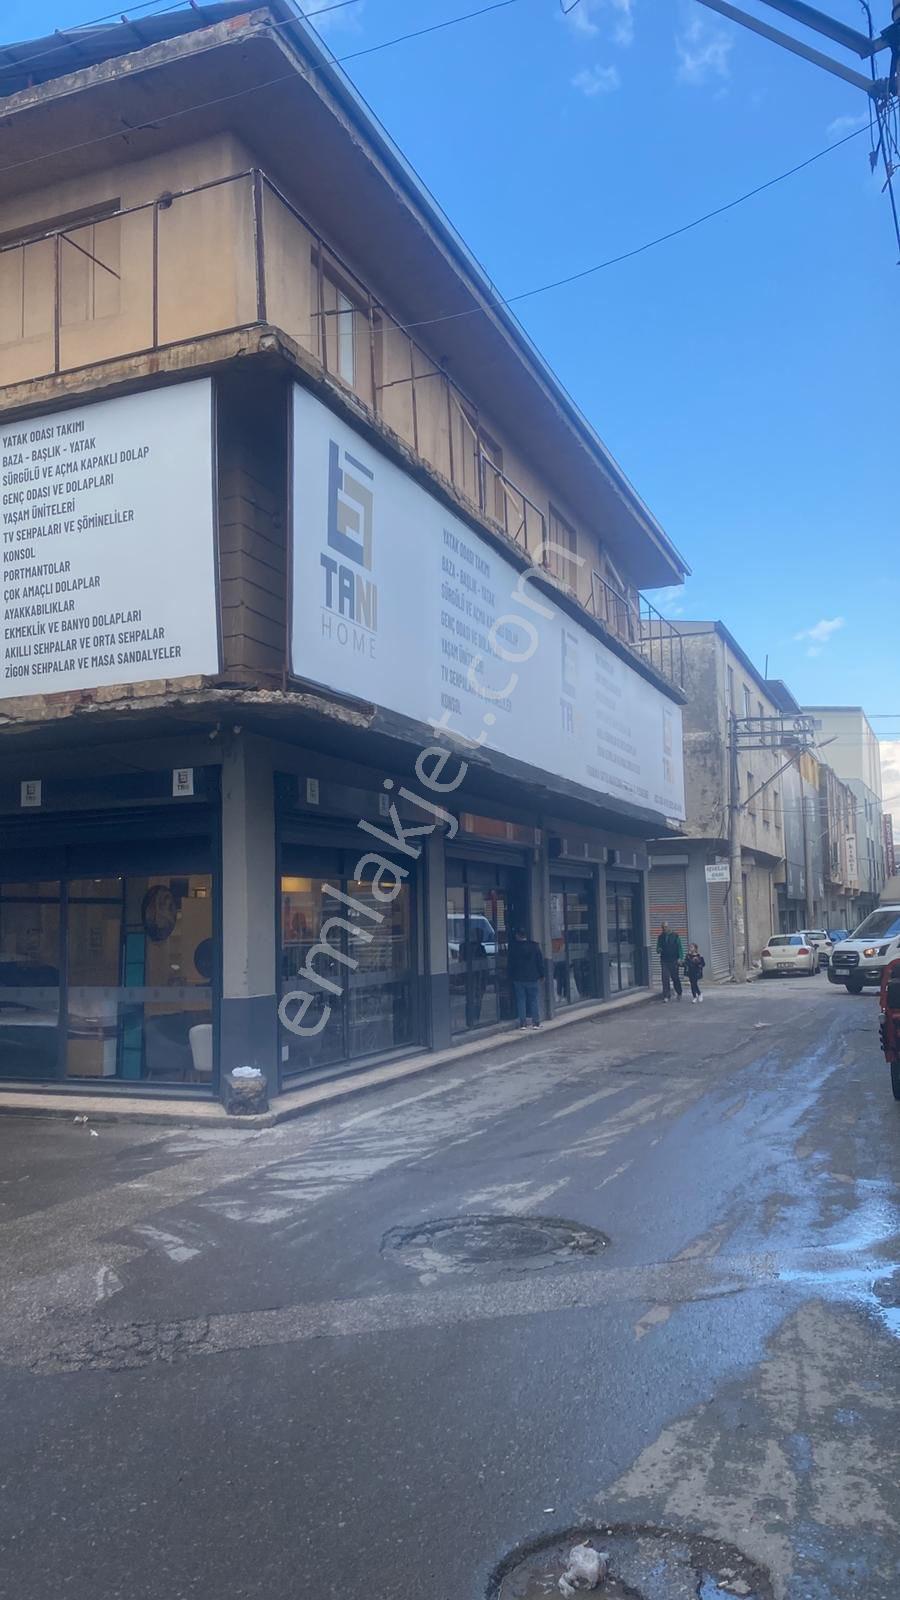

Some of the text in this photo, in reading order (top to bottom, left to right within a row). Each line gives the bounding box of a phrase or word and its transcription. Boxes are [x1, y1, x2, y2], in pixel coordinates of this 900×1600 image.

[3, 420, 85, 449] YATAK ODASI TAKIMI
[3, 453, 23, 467] BAZA
[31, 445, 61, 462] BAŞLIK
[70, 437, 96, 454] YATAK
[3, 446, 150, 486] SÜRGÜLÜ VE AÇMA KAPAKLI DOLAP
[3, 473, 114, 505] GENÇ ODASI VE DOLAPLARI
[3, 497, 75, 525] YAŞAM ÜNİTELERİ
[3, 509, 134, 544] TV SEHPALARI VE ŞÖMİNELİLER
[3, 547, 36, 563] KONSOL
[3, 560, 71, 582] PORTMANTOLAR
[4, 575, 101, 603] ÇOK AMAÇLI DOLAPLAR
[320, 552, 378, 632] TANI
[4, 599, 75, 620] AYAKKABILIKLAR
[5, 609, 142, 640] EKMEKLİK VE BANYO DOLAPLARI
[5, 627, 165, 659] AKILLI SEHPALAR VE ORTA SEHPALAR
[321, 613, 376, 660] HOME
[5, 645, 182, 679] ZİGON SEHPALAR VE MASA SANDALYELER
